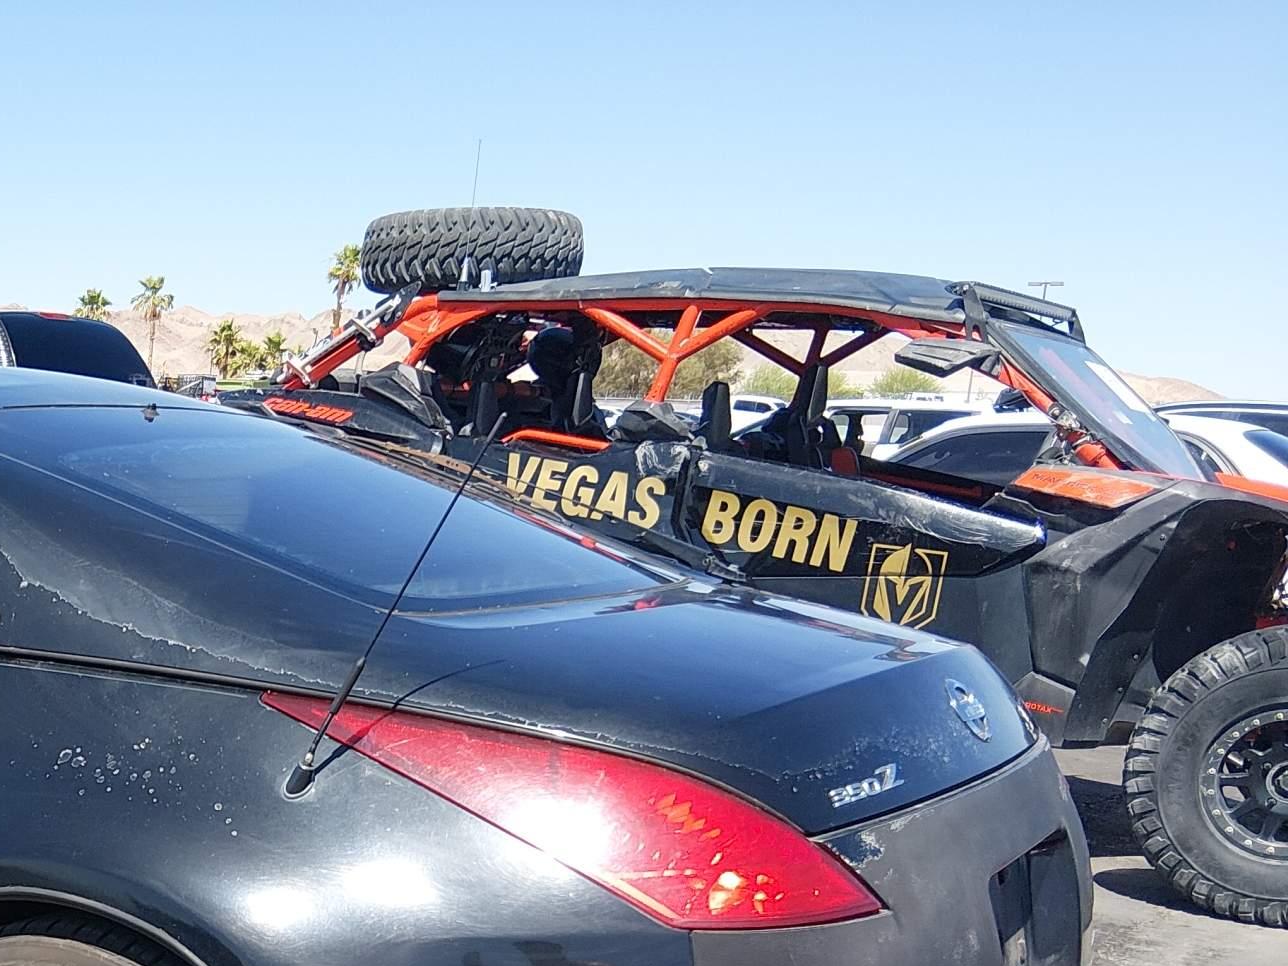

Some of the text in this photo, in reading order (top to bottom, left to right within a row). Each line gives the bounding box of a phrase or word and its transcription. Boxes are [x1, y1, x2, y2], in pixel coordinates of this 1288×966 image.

[506, 453, 858, 572] VEGAS BORN
[828, 763, 904, 808] 350Z
